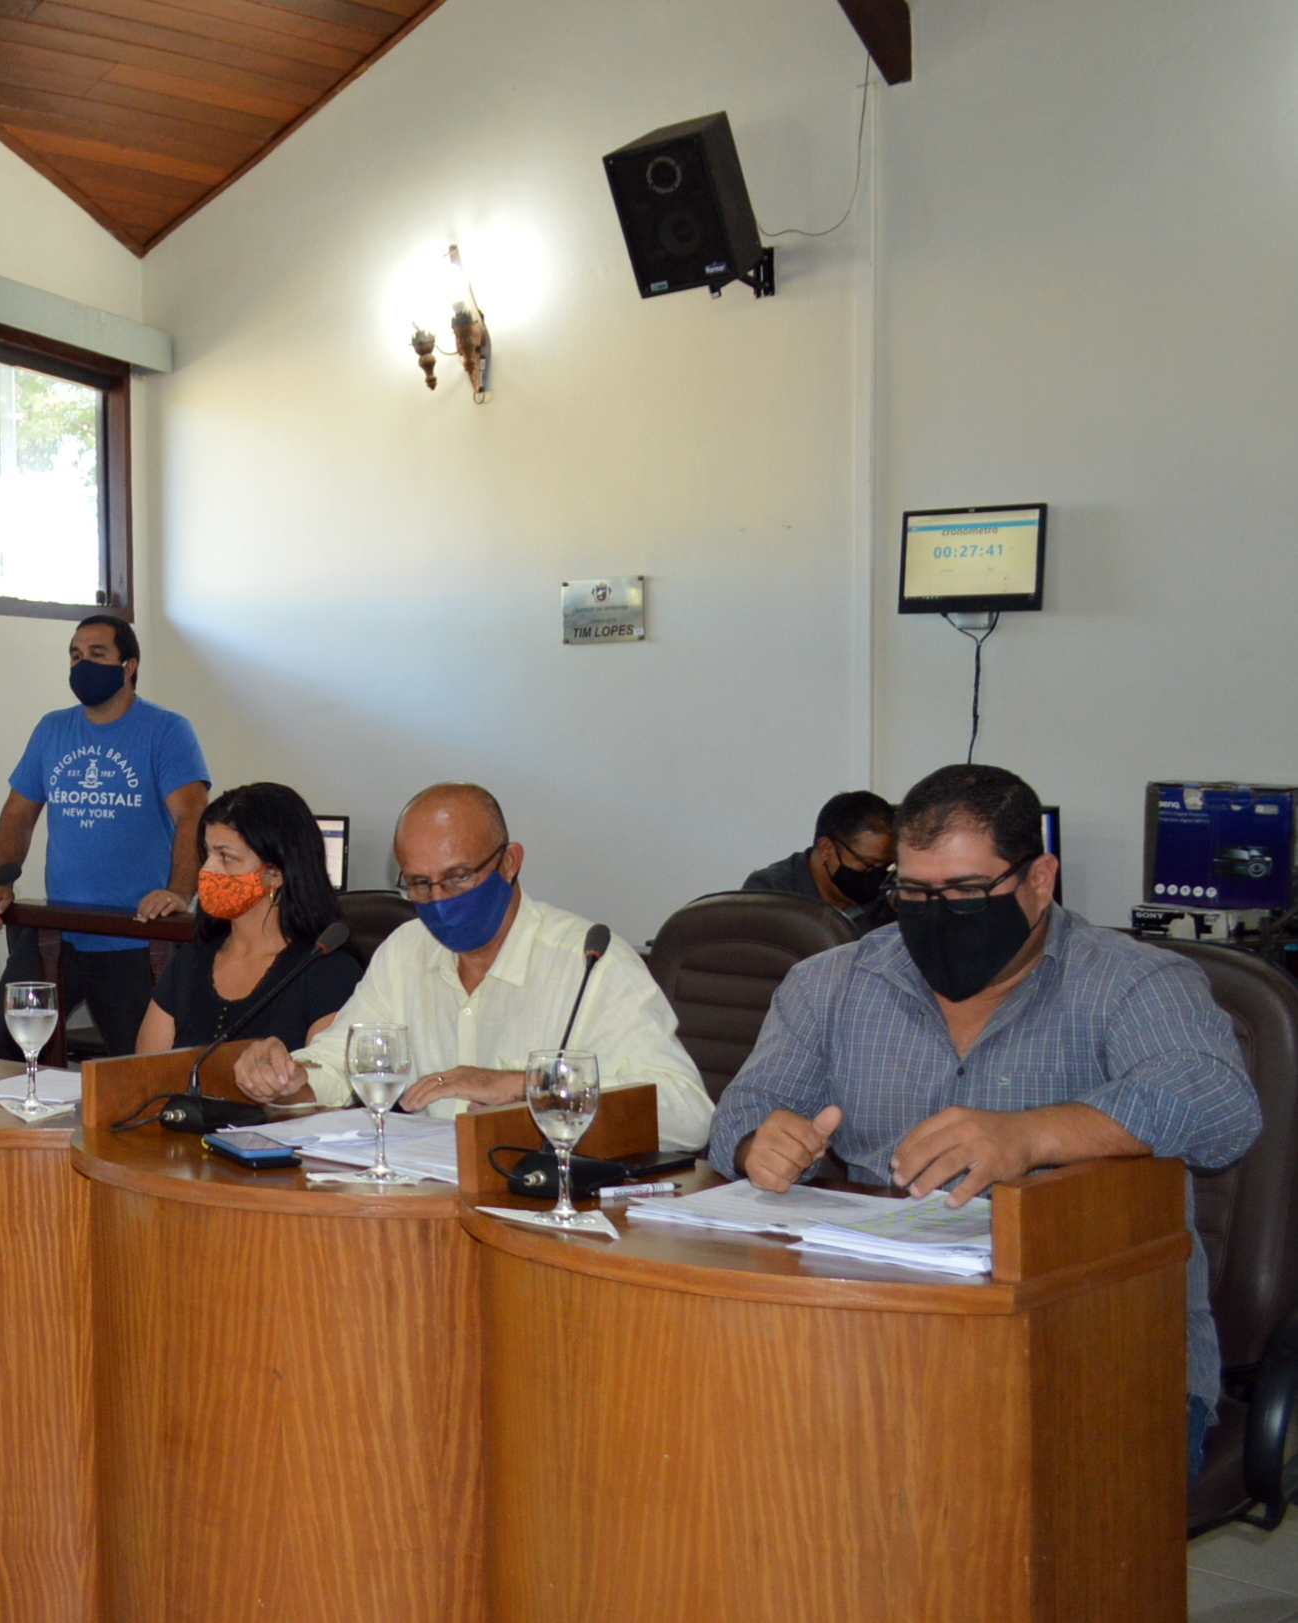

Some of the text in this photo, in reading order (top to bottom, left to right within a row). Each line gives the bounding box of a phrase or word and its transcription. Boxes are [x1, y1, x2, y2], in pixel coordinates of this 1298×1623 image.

[933, 543, 1004, 558] 00:27:41
[573, 627, 592, 639] TIM
[594, 624, 634, 638] LOPES
[49, 745, 139, 788] ORIGINAL BRAND
[67, 769, 117, 778] EST. 1987
[48, 787, 142, 807] AÉROPOSTALE
[62, 807, 116, 819] NEW YORK
[80, 819, 95, 828] NY
[1135, 911, 1164, 919] SONY
